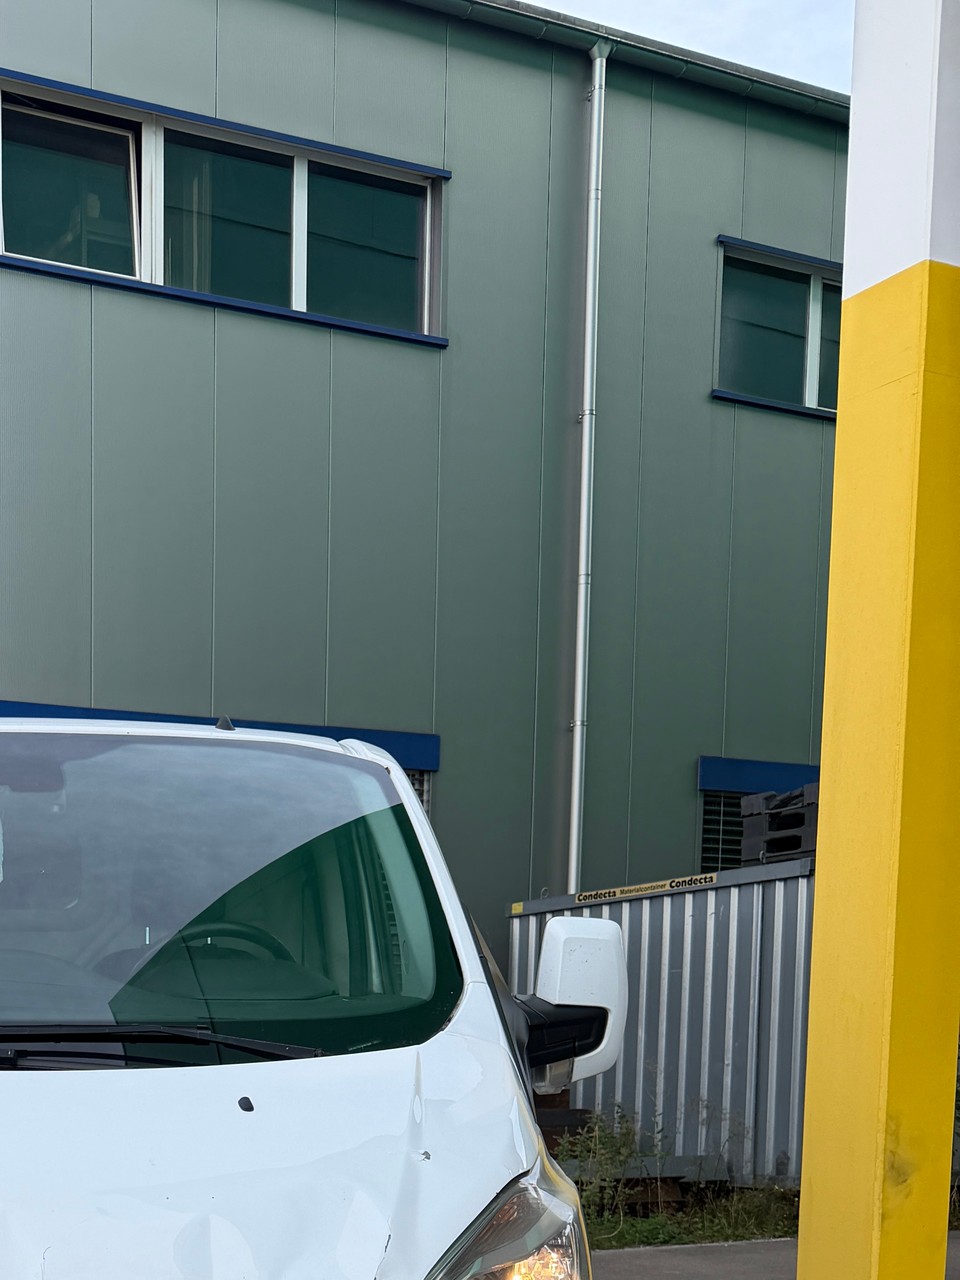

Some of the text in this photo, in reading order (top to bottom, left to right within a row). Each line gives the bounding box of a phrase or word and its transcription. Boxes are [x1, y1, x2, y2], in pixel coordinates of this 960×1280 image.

[577, 875, 714, 902] Condecta Materialcontainer Condecta
